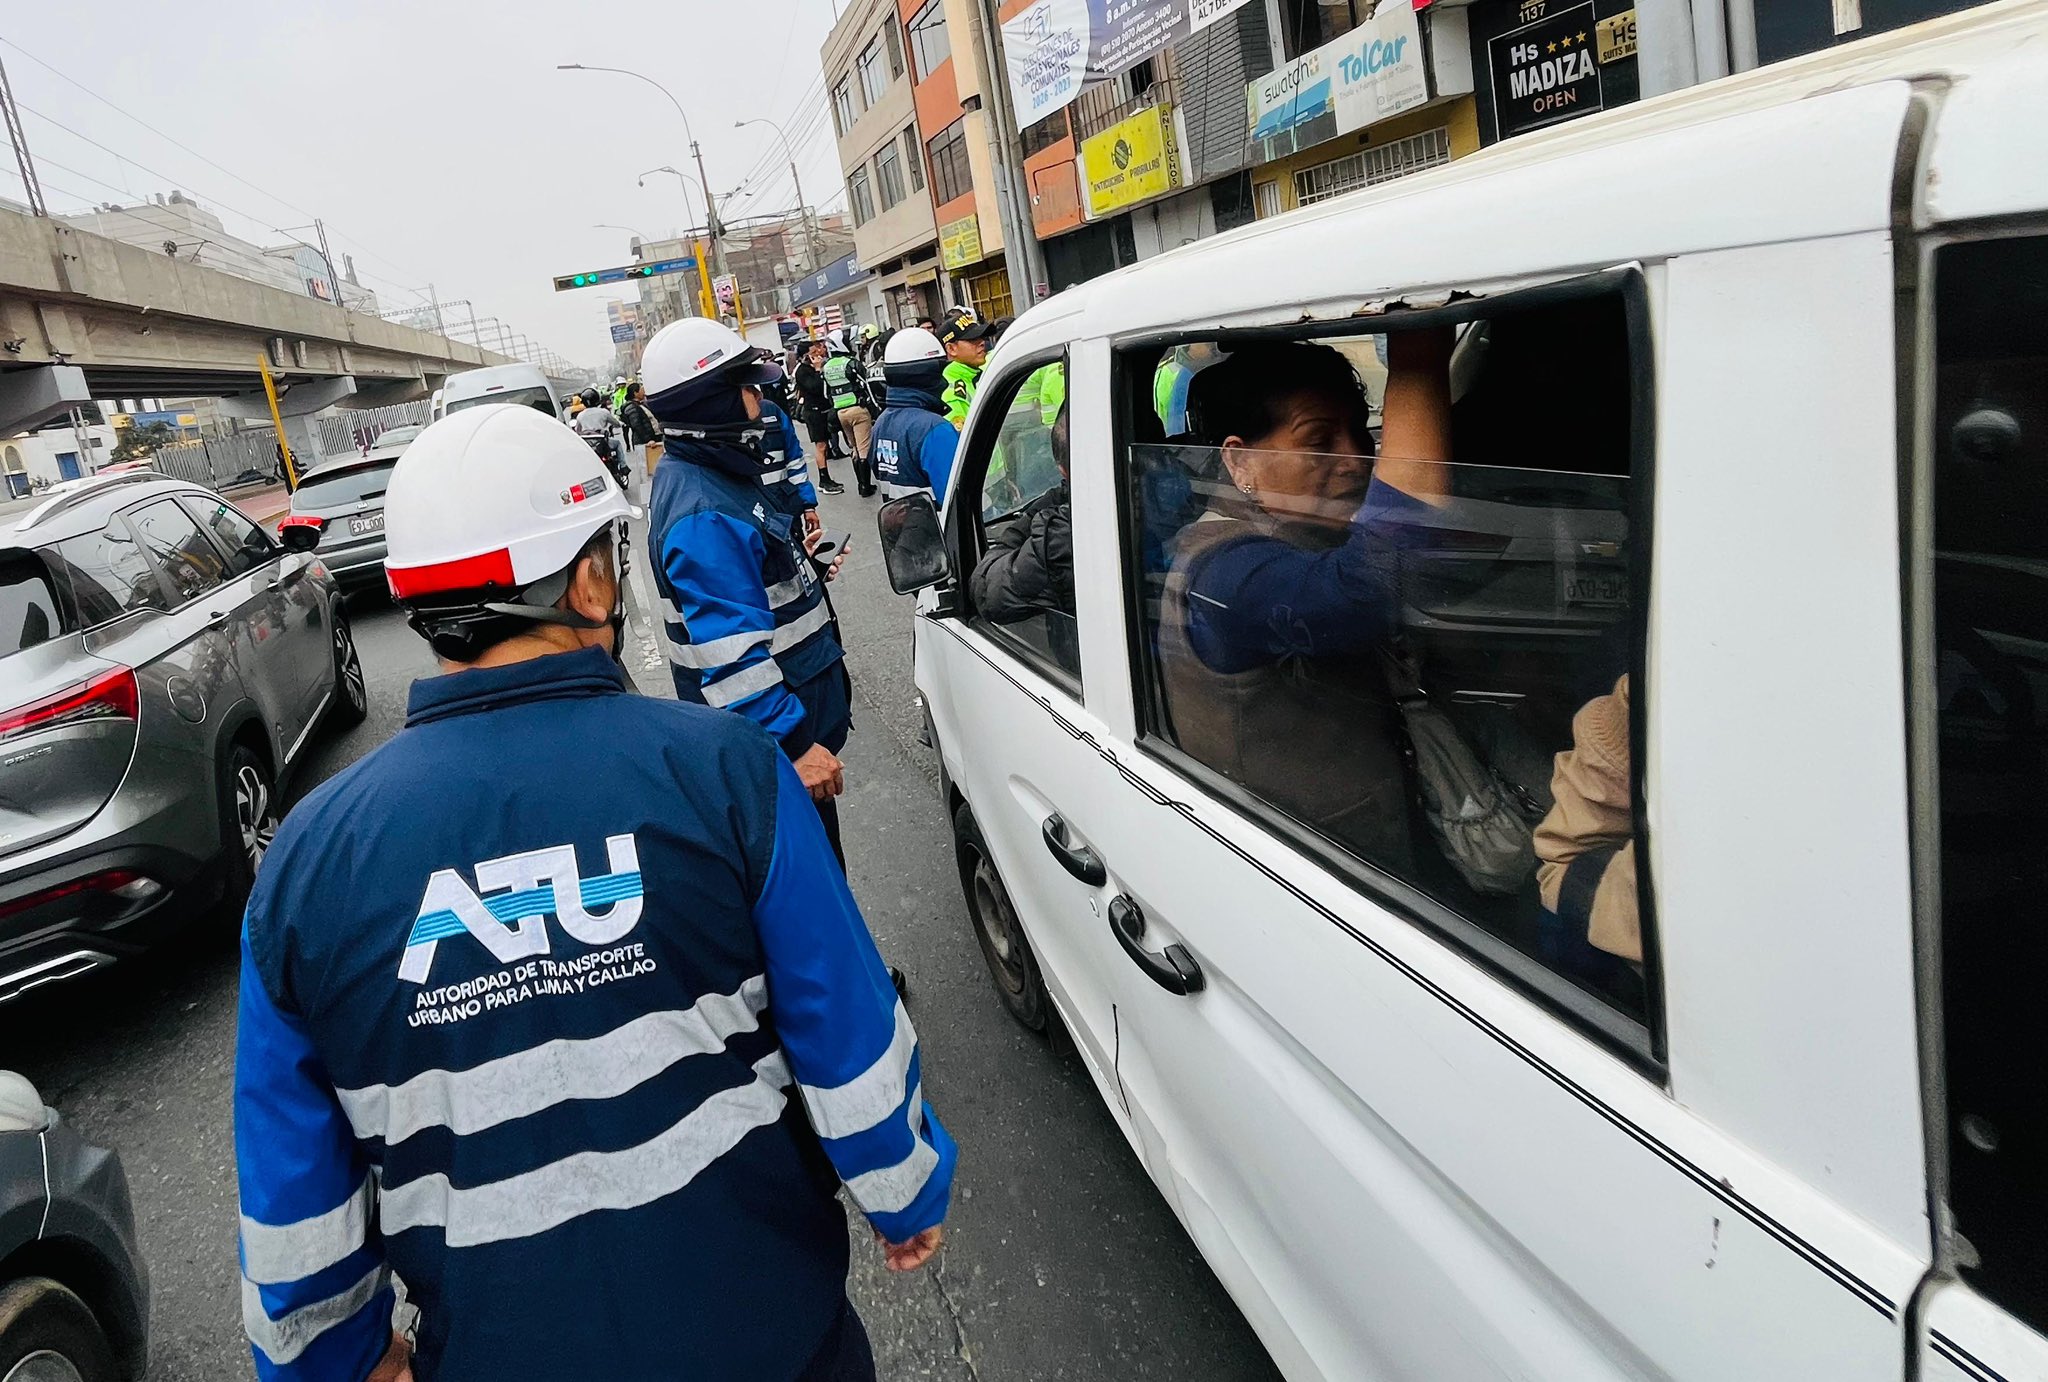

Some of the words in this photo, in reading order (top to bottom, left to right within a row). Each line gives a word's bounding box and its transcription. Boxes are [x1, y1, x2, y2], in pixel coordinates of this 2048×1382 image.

[1106, 9, 1112, 24] 8
[1209, 2, 1214, 14] 7
[1519, 3, 1546, 24] 1137
[1042, 39, 1081, 69] VECINALES
[1338, 35, 1408, 85] TolCar
[1510, 43, 1539, 66] Hs
[1602, 46, 1624, 61] SUITS
[1031, 61, 1071, 94] COMUNALES
[1510, 49, 1596, 99] MADIZA
[1032, 89, 1049, 109] 2026
[1533, 88, 1577, 113] OPEN
[1161, 109, 1178, 185] ANTICUCHOS
[397, 833, 644, 985] ATU
[416, 969, 511, 1009] AUTORIDAD
[514, 963, 538, 984] DE
[539, 943, 645, 977] TRANSPORTE
[407, 998, 482, 1028] URBANO
[484, 986, 533, 1011] PARA
[535, 976, 574, 996] LIMA
[574, 977, 587, 993] Y
[587, 958, 657, 986] CALLAO
